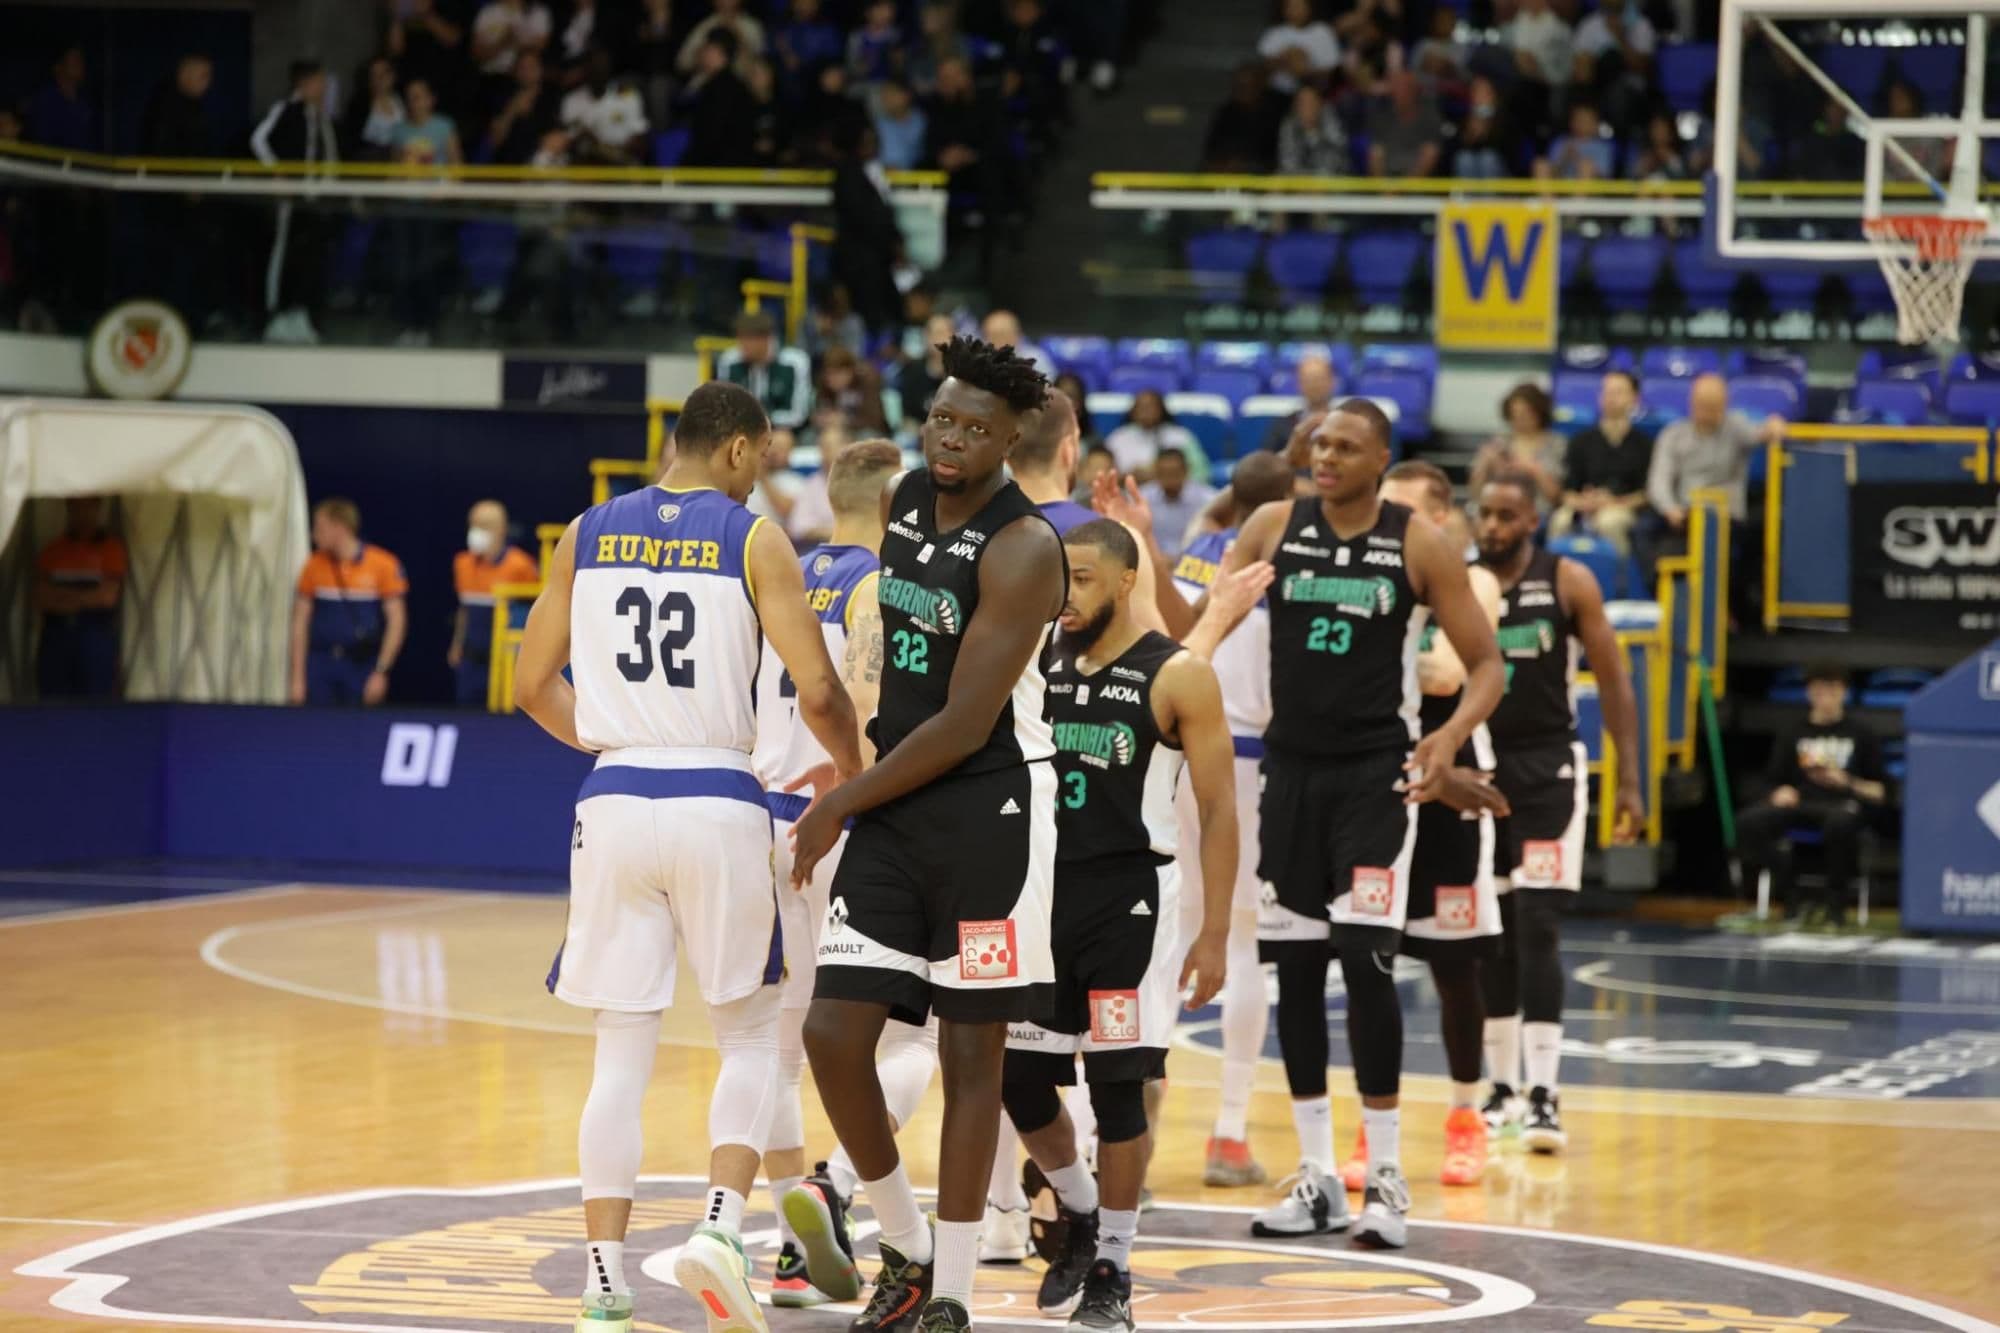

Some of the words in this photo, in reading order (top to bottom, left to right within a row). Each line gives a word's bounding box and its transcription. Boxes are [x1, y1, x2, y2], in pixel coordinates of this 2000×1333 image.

[1453, 219, 1545, 304] W
[597, 535, 721, 570] HUNTER
[615, 586, 696, 689] 32
[892, 629, 929, 675] 32
[1307, 616, 1353, 655] 23
[381, 722, 459, 788] DI
